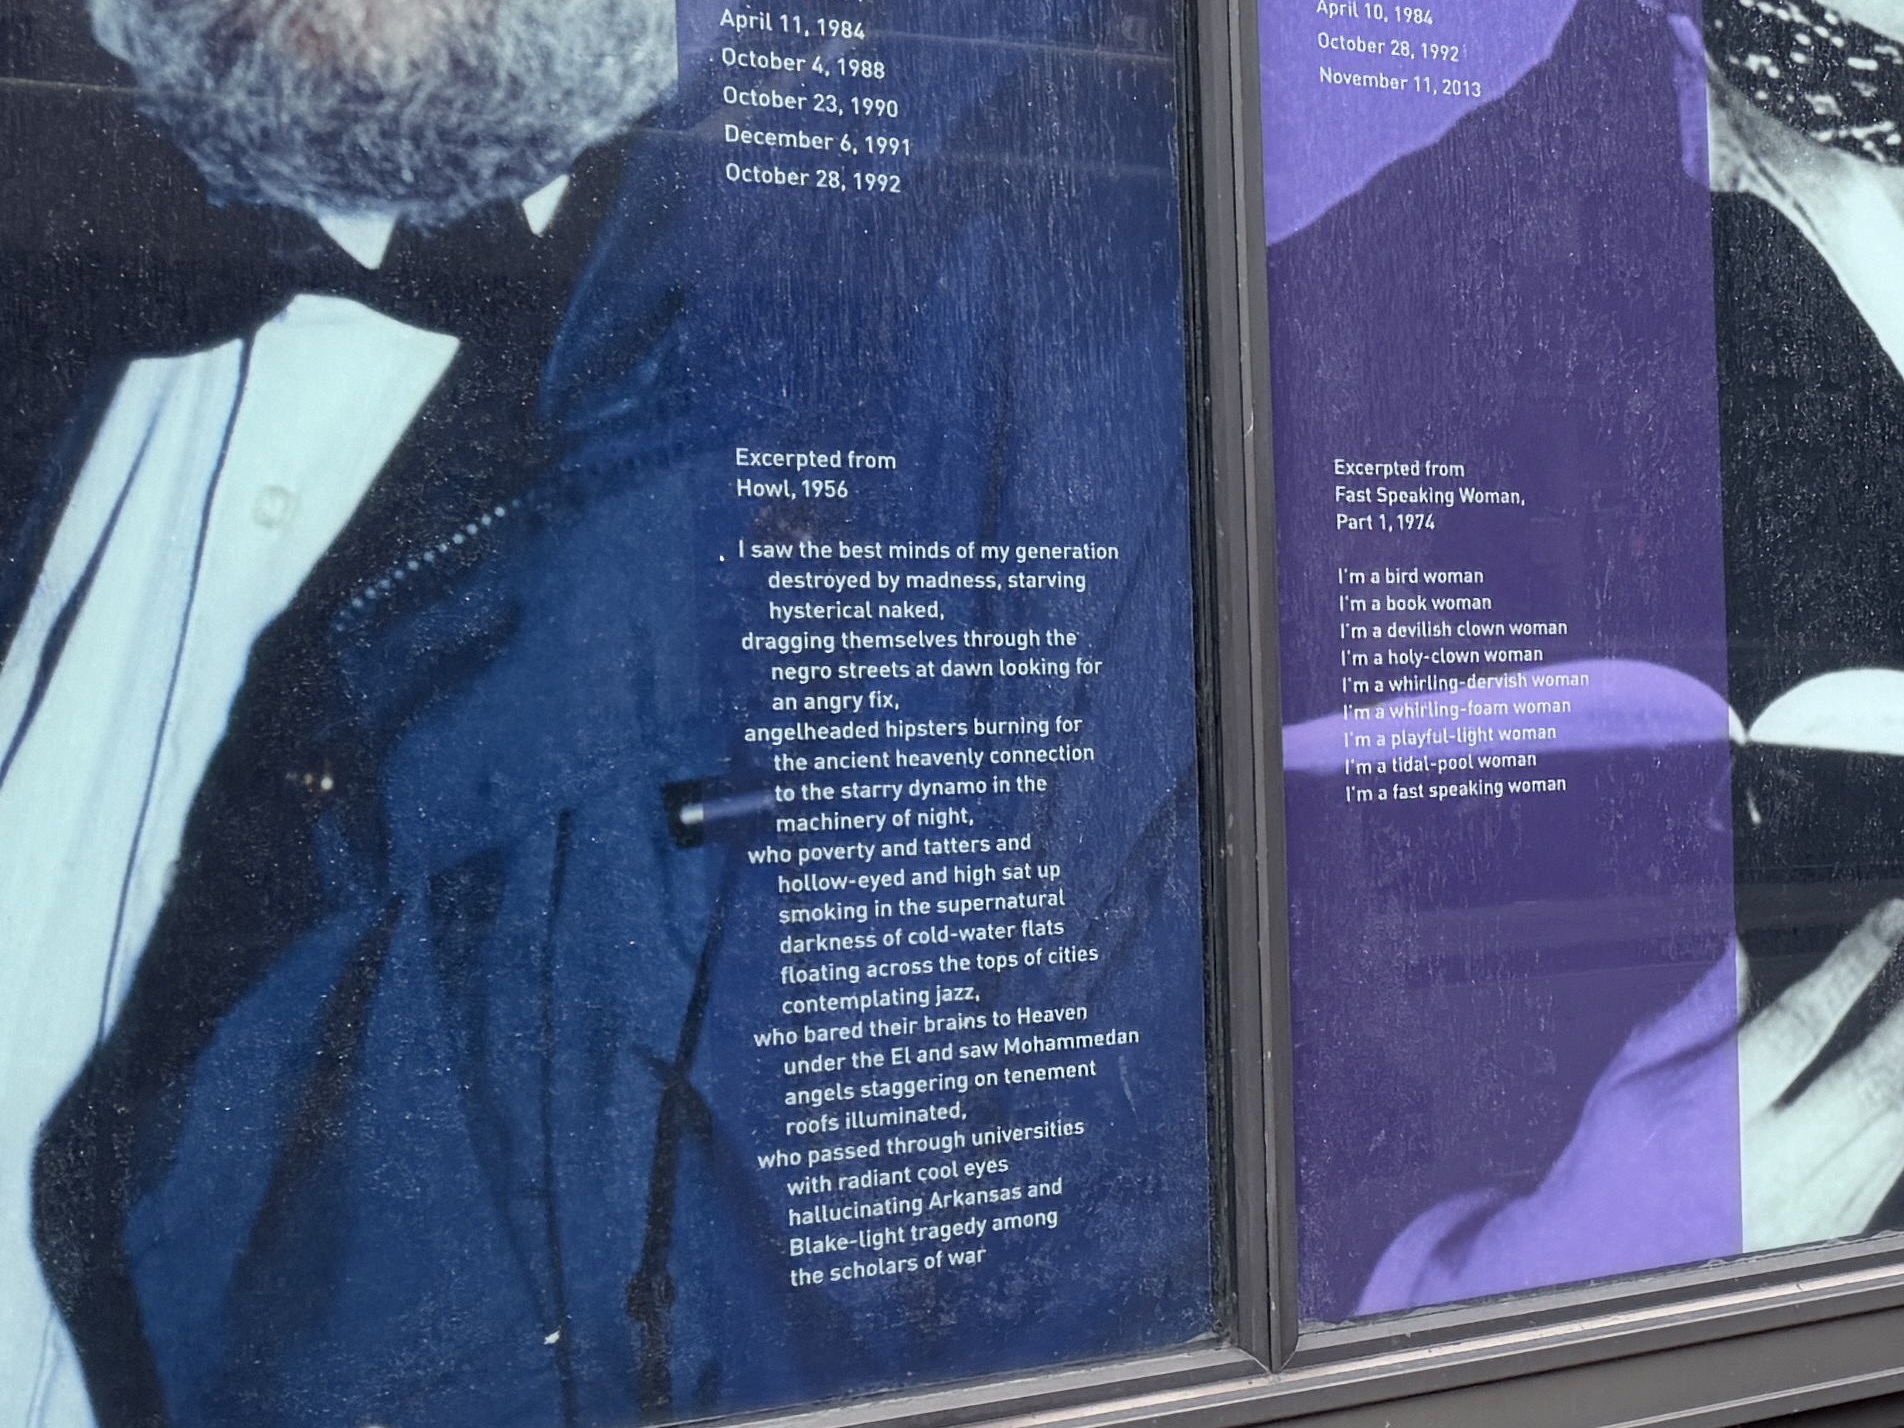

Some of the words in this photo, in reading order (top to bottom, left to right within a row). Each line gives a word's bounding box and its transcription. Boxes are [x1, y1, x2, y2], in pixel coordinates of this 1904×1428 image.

[720, 9, 772, 32] April
[780, 14, 809, 37] 11,
[818, 18, 865, 39] 1984
[1365, 3, 1388, 22] 10,
[1395, 6, 1432, 24] 1984
[1318, 32, 1385, 54] October
[1391, 40, 1414, 59] 28,
[1422, 43, 1458, 62] 1992
[722, 48, 806, 71] October
[812, 56, 829, 77] 4,
[838, 58, 885, 79] 1988
[1320, 66, 1408, 90] November
[1414, 76, 1437, 95] 11,
[1443, 79, 1480, 97] 2013
[723, 86, 807, 110] October
[814, 94, 843, 116] 23,
[852, 97, 898, 117] 1990
[725, 124, 833, 150] December
[840, 134, 857, 154] 6,
[866, 136, 909, 156] 1991
[726, 163, 809, 185] October
[817, 170, 845, 191] 28,
[854, 173, 900, 192] 1992
[736, 448, 841, 471] Excerpted
[848, 451, 895, 469] from
[1335, 459, 1420, 479] Excerpted
[1426, 460, 1464, 477] from
[737, 479, 796, 500] Howl,
[802, 480, 848, 498] 1956
[1336, 486, 1371, 502] Fast
[1377, 485, 1454, 507] Speaking
[1459, 487, 1524, 505] Woman,
[1337, 514, 1372, 530] Part
[1379, 514, 1392, 532] 1,
[1397, 514, 1435, 530] 1974
[739, 540, 744, 557] I
[752, 545, 793, 558] saw
[799, 540, 832, 558] the
[839, 541, 882, 558] best
[890, 541, 950, 558] minds
[957, 542, 974, 558] of
[981, 546, 1009, 563] my
[1016, 542, 1118, 563] generation
[769, 571, 870, 592] destroyed
[878, 571, 900, 592] by
[907, 571, 1001, 590] madness,
[1008, 571, 1085, 592] starving
[1339, 568, 1365, 584] I'm
[1371, 572, 1380, 584] a
[1386, 568, 1418, 584] bird
[1424, 572, 1483, 583] woman
[770, 601, 872, 623] hysterical
[879, 601, 944, 620] naked,
[742, 632, 834, 654] dragging
[842, 630, 957, 649] themselves
[964, 629, 1040, 650] through
[1046, 629, 1076, 646] the
[1341, 623, 1367, 638] I'm
[1373, 626, 1381, 638] a
[1388, 621, 1451, 637] devilish
[1457, 621, 1504, 636] clown
[1509, 623, 1567, 635] woman
[1342, 650, 1368, 666] I'm
[1374, 653, 1382, 665] a
[1389, 648, 1479, 668] holy-clown
[1484, 650, 1542, 662] woman
[772, 666, 831, 684] negro
[839, 662, 910, 678] streets
[916, 661, 934, 677] at
[941, 660, 993, 677] dawn
[1000, 658, 1069, 679] looking
[1076, 657, 1102, 674] for
[773, 697, 797, 710] an
[804, 695, 863, 714] angry
[869, 691, 899, 710] fix,
[745, 721, 878, 745] angelheaded
[886, 720, 967, 741] hipsters
[974, 717, 1049, 737] burning
[1056, 716, 1082, 732] for
[774, 754, 807, 771] the
[814, 751, 889, 769] ancient
[896, 748, 984, 768] heavenly
[990, 744, 1094, 763] connection
[1346, 786, 1372, 802] I'm
[1378, 789, 1387, 800] a
[1393, 784, 1423, 799] fast
[1429, 780, 1503, 801] speaking
[1508, 779, 1566, 793] woman
[758, 1150, 801, 1168] who
[809, 1144, 880, 1168] passed
[887, 1131, 965, 1154] through
[972, 1120, 1084, 1146] universities
[790, 1227, 905, 1256] Blake-light
[911, 1217, 986, 1242] tragedy
[993, 1211, 1057, 1231] among
[791, 1268, 823, 1286] the
[830, 1258, 918, 1281] scholars
[924, 1251, 942, 1269] of
[948, 1249, 986, 1265] war
